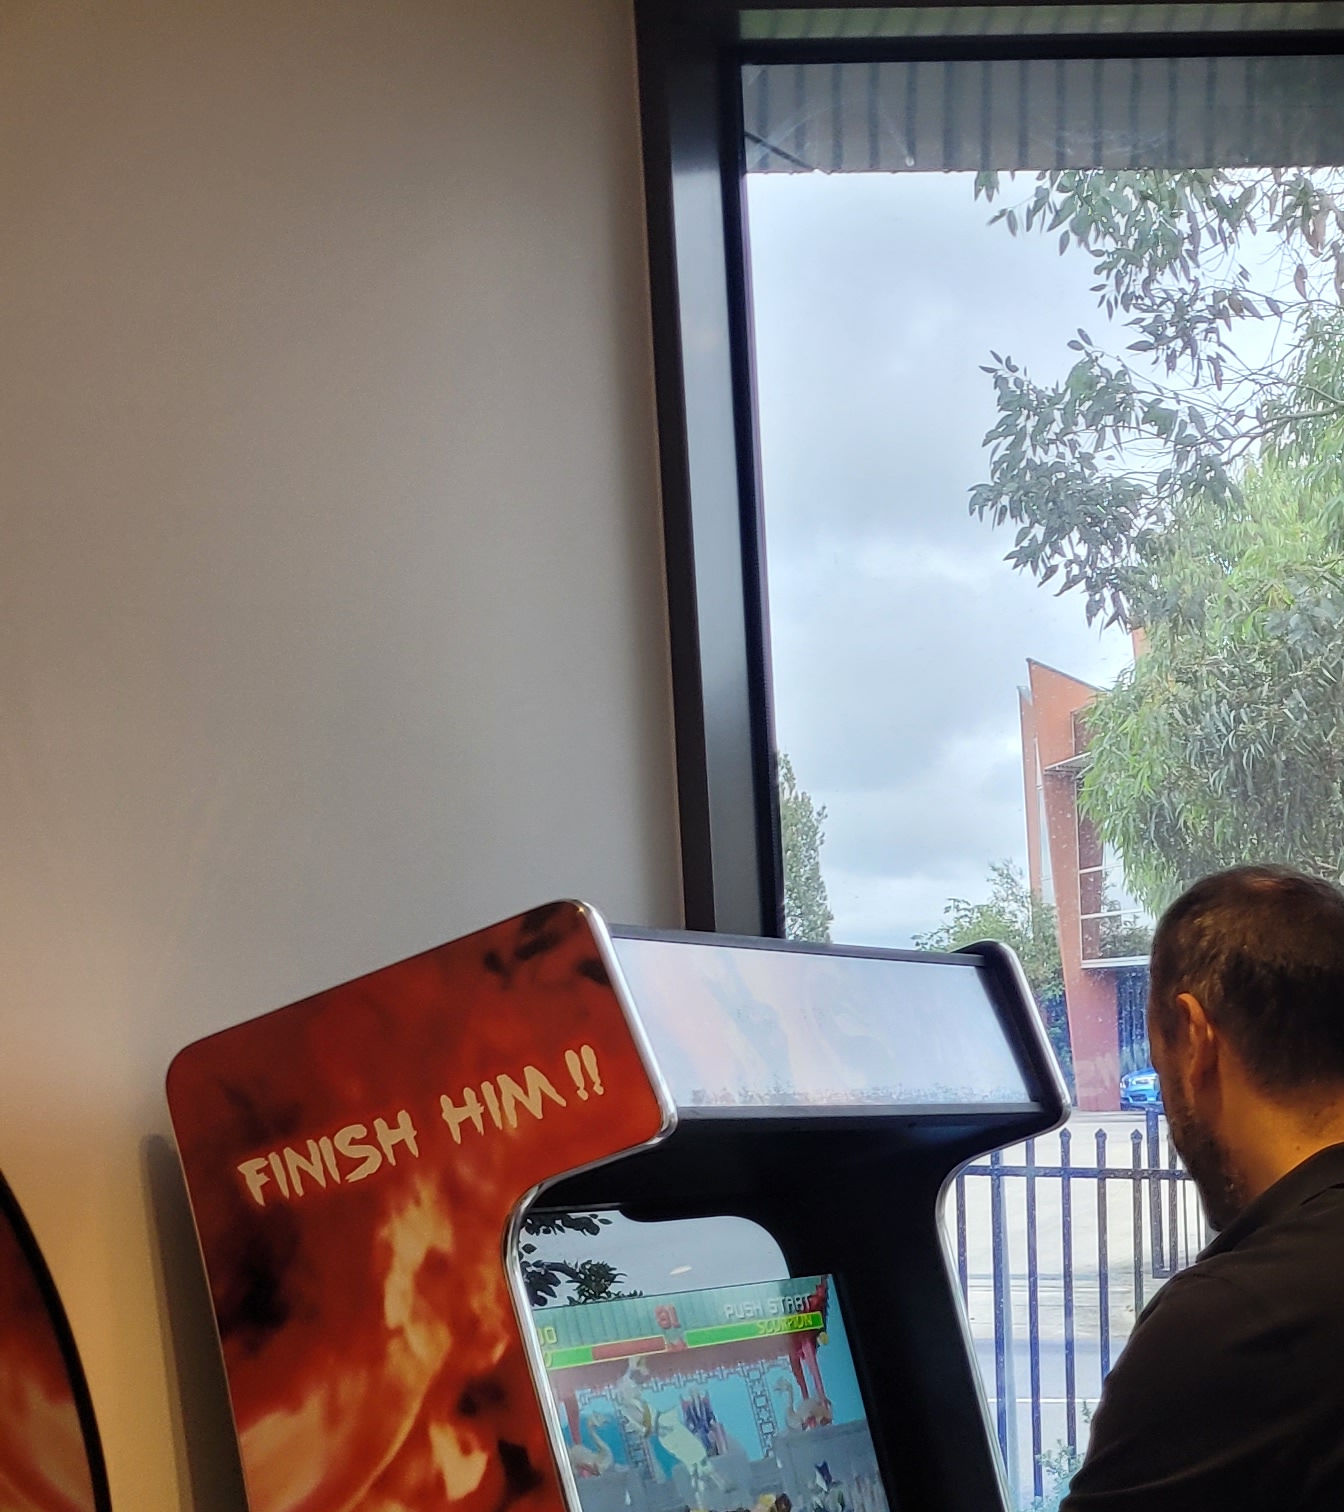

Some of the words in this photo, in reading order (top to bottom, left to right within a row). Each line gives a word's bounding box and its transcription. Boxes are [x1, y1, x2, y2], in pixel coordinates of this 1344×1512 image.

[238, 1109, 418, 1206] FINISH
[724, 1301, 764, 1320] PUSH
[767, 1293, 811, 1315] START
[756, 1314, 813, 1334] SCORPION
